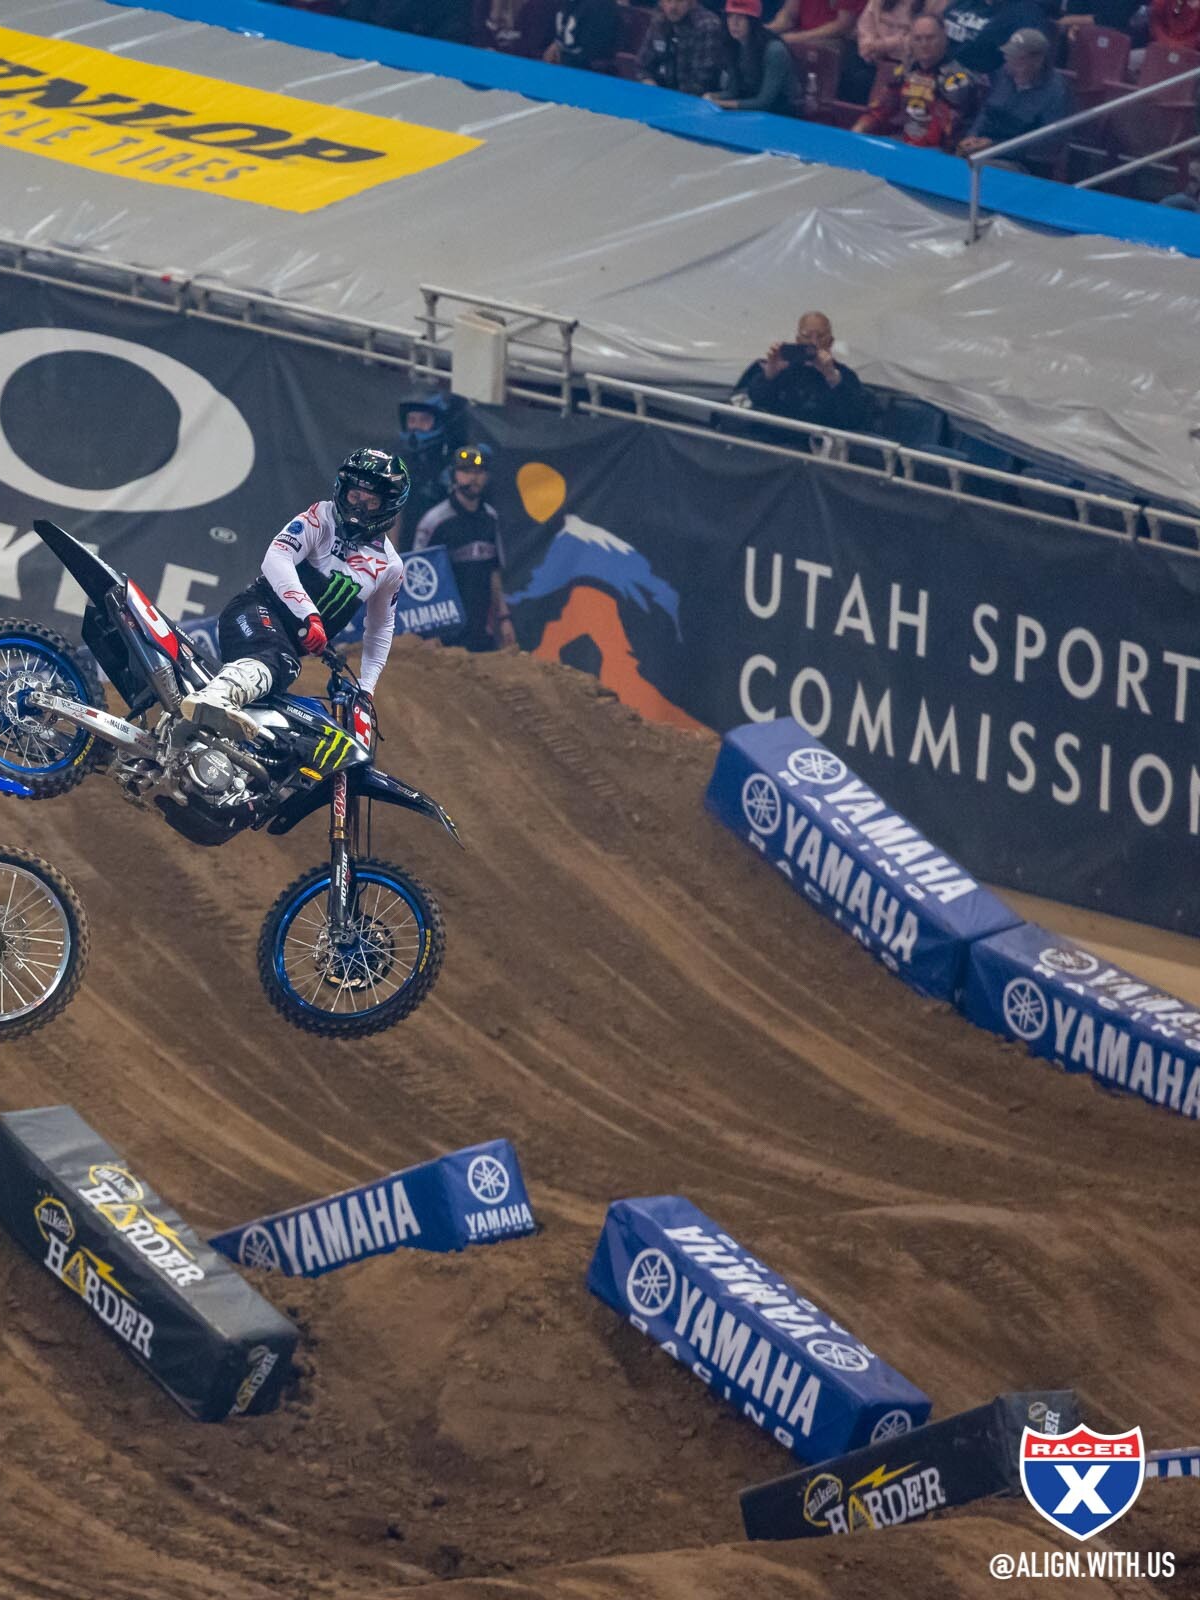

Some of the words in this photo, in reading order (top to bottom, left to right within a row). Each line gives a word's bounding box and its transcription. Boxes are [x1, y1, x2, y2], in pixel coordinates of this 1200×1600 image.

[89, 136, 259, 183] TIRES
[399, 599, 460, 628] YAMAHA
[744, 546, 929, 658] UTAH
[969, 602, 1200, 724] SPORT
[784, 804, 919, 964] YAMAHA
[823, 780, 980, 904] YAMAHA
[1053, 997, 1200, 1121] YAMAHA
[78, 1181, 205, 1288] HARDER
[274, 1179, 422, 1276] YAMAHA
[465, 1202, 534, 1234] YAMAHA
[43, 1232, 155, 1359] HARDER
[663, 1225, 828, 1339] YAMAHA
[673, 1275, 822, 1438] YAMAHA
[824, 1466, 947, 1535] HARDER
